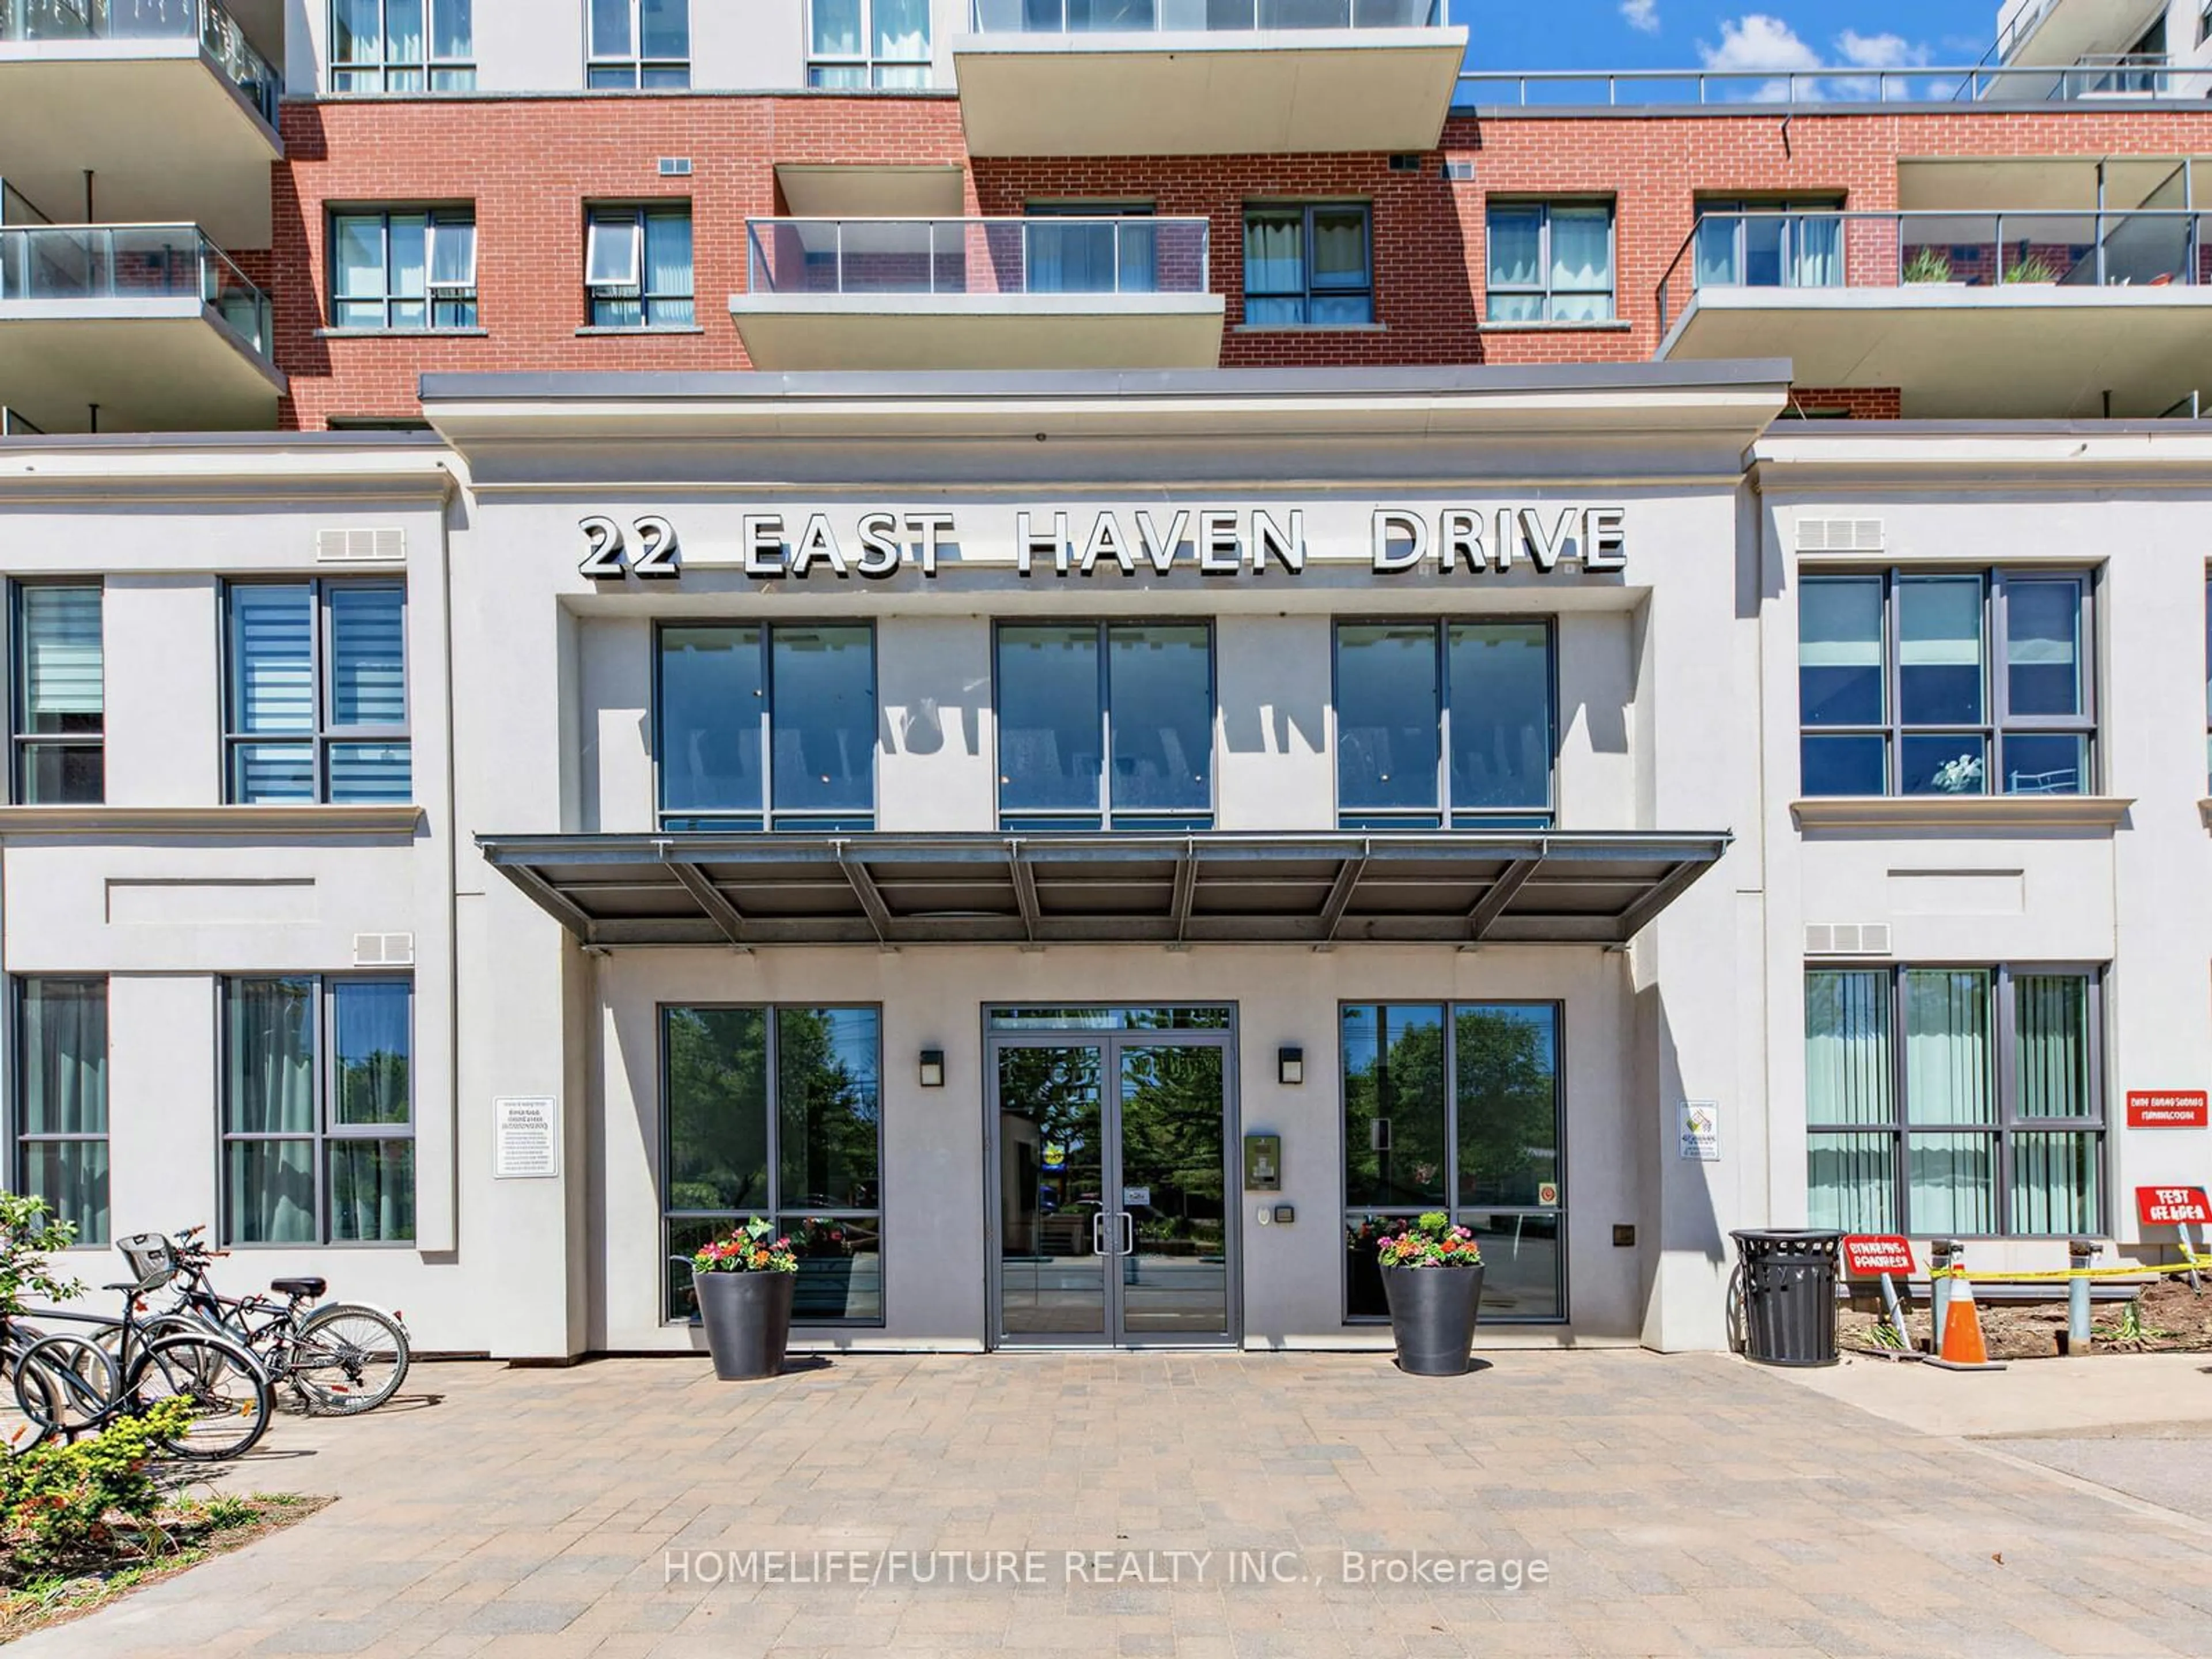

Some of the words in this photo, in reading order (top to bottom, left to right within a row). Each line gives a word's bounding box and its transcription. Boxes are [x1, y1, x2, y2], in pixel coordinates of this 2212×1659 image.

[578, 516, 681, 578] 22
[743, 512, 956, 578] EAST
[1017, 510, 1304, 577] HAVEN
[1372, 508, 1627, 574] DRIVE
[2156, 1190, 2188, 1205] TEST
